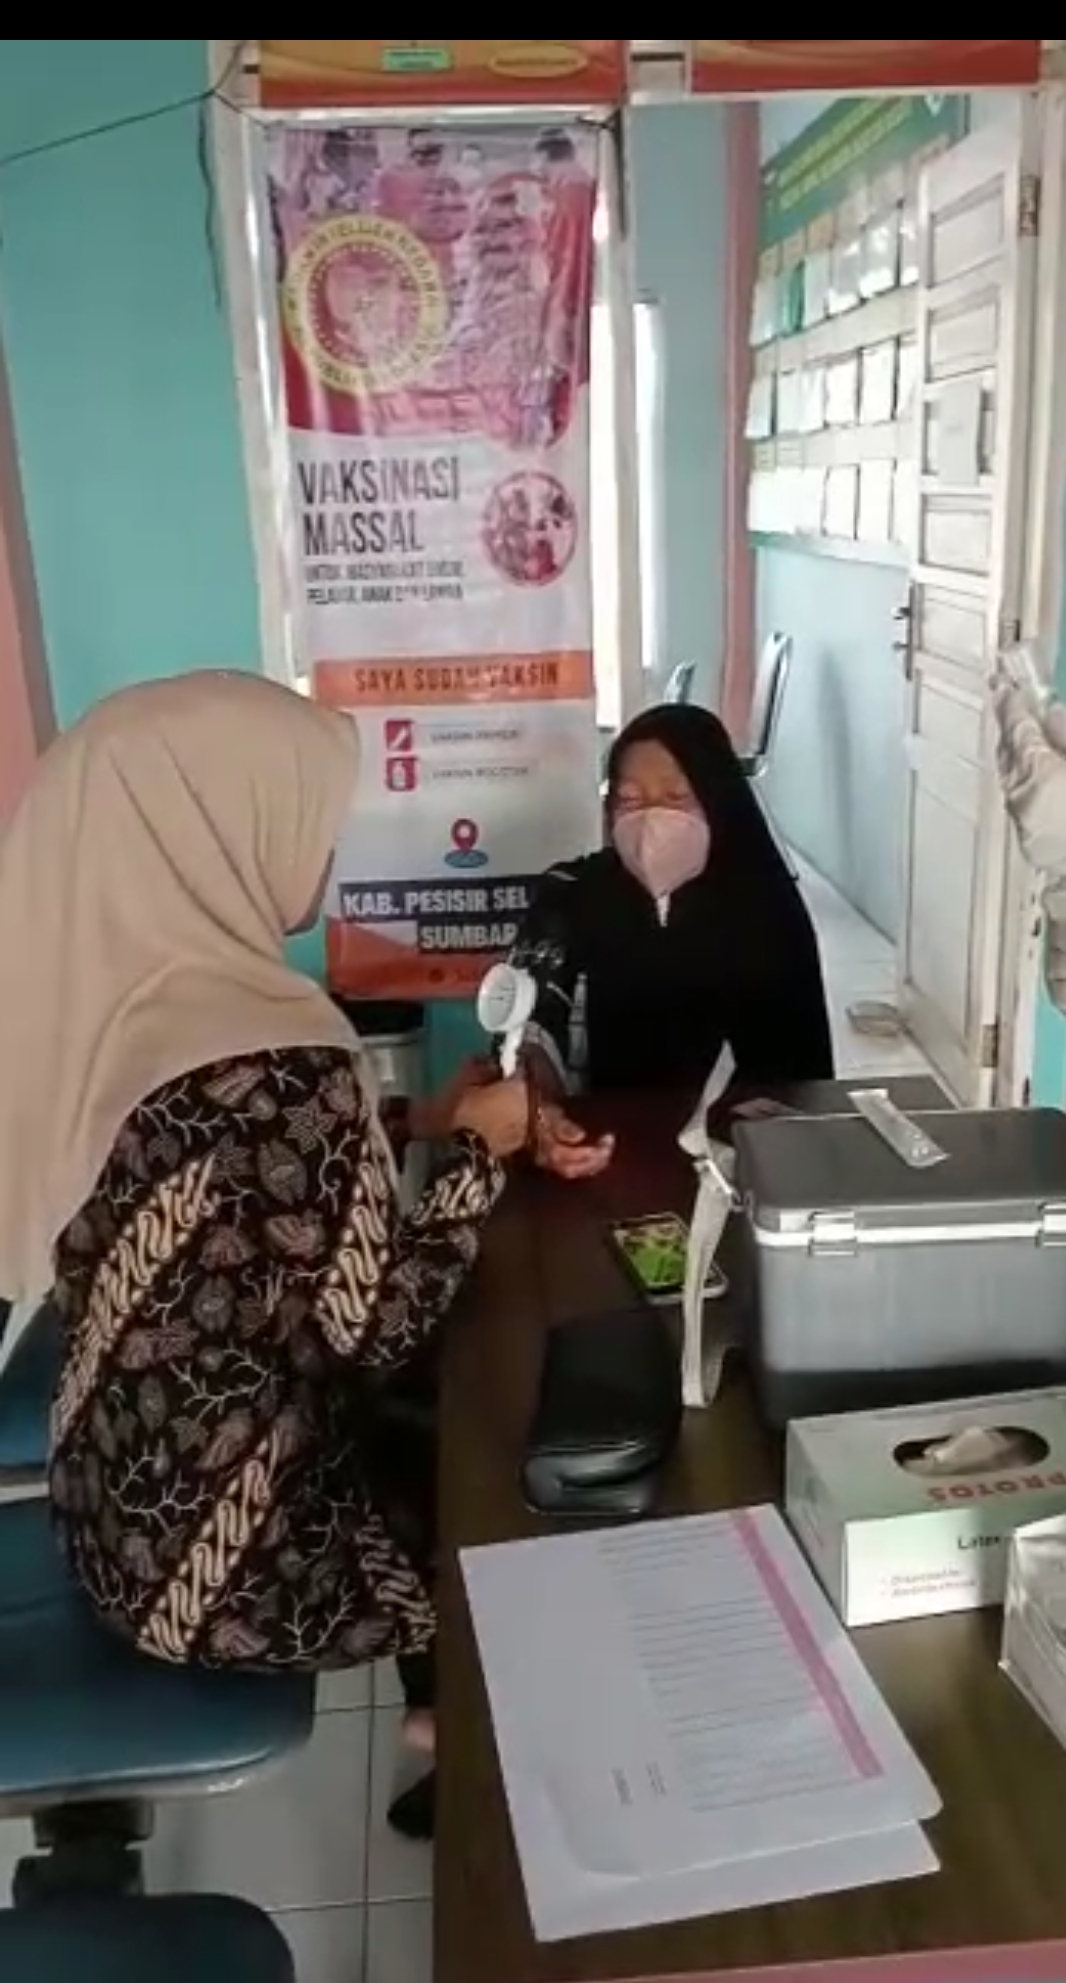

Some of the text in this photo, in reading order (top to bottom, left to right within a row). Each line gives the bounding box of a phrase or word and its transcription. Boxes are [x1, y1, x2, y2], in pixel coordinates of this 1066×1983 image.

[297, 456, 460, 504] VAKSINASI
[303, 509, 425, 556] MASSAL
[354, 662, 560, 692] SAYA SUDAH VAKSIN
[343, 885, 530, 917] KAB. PESISIR SEL
